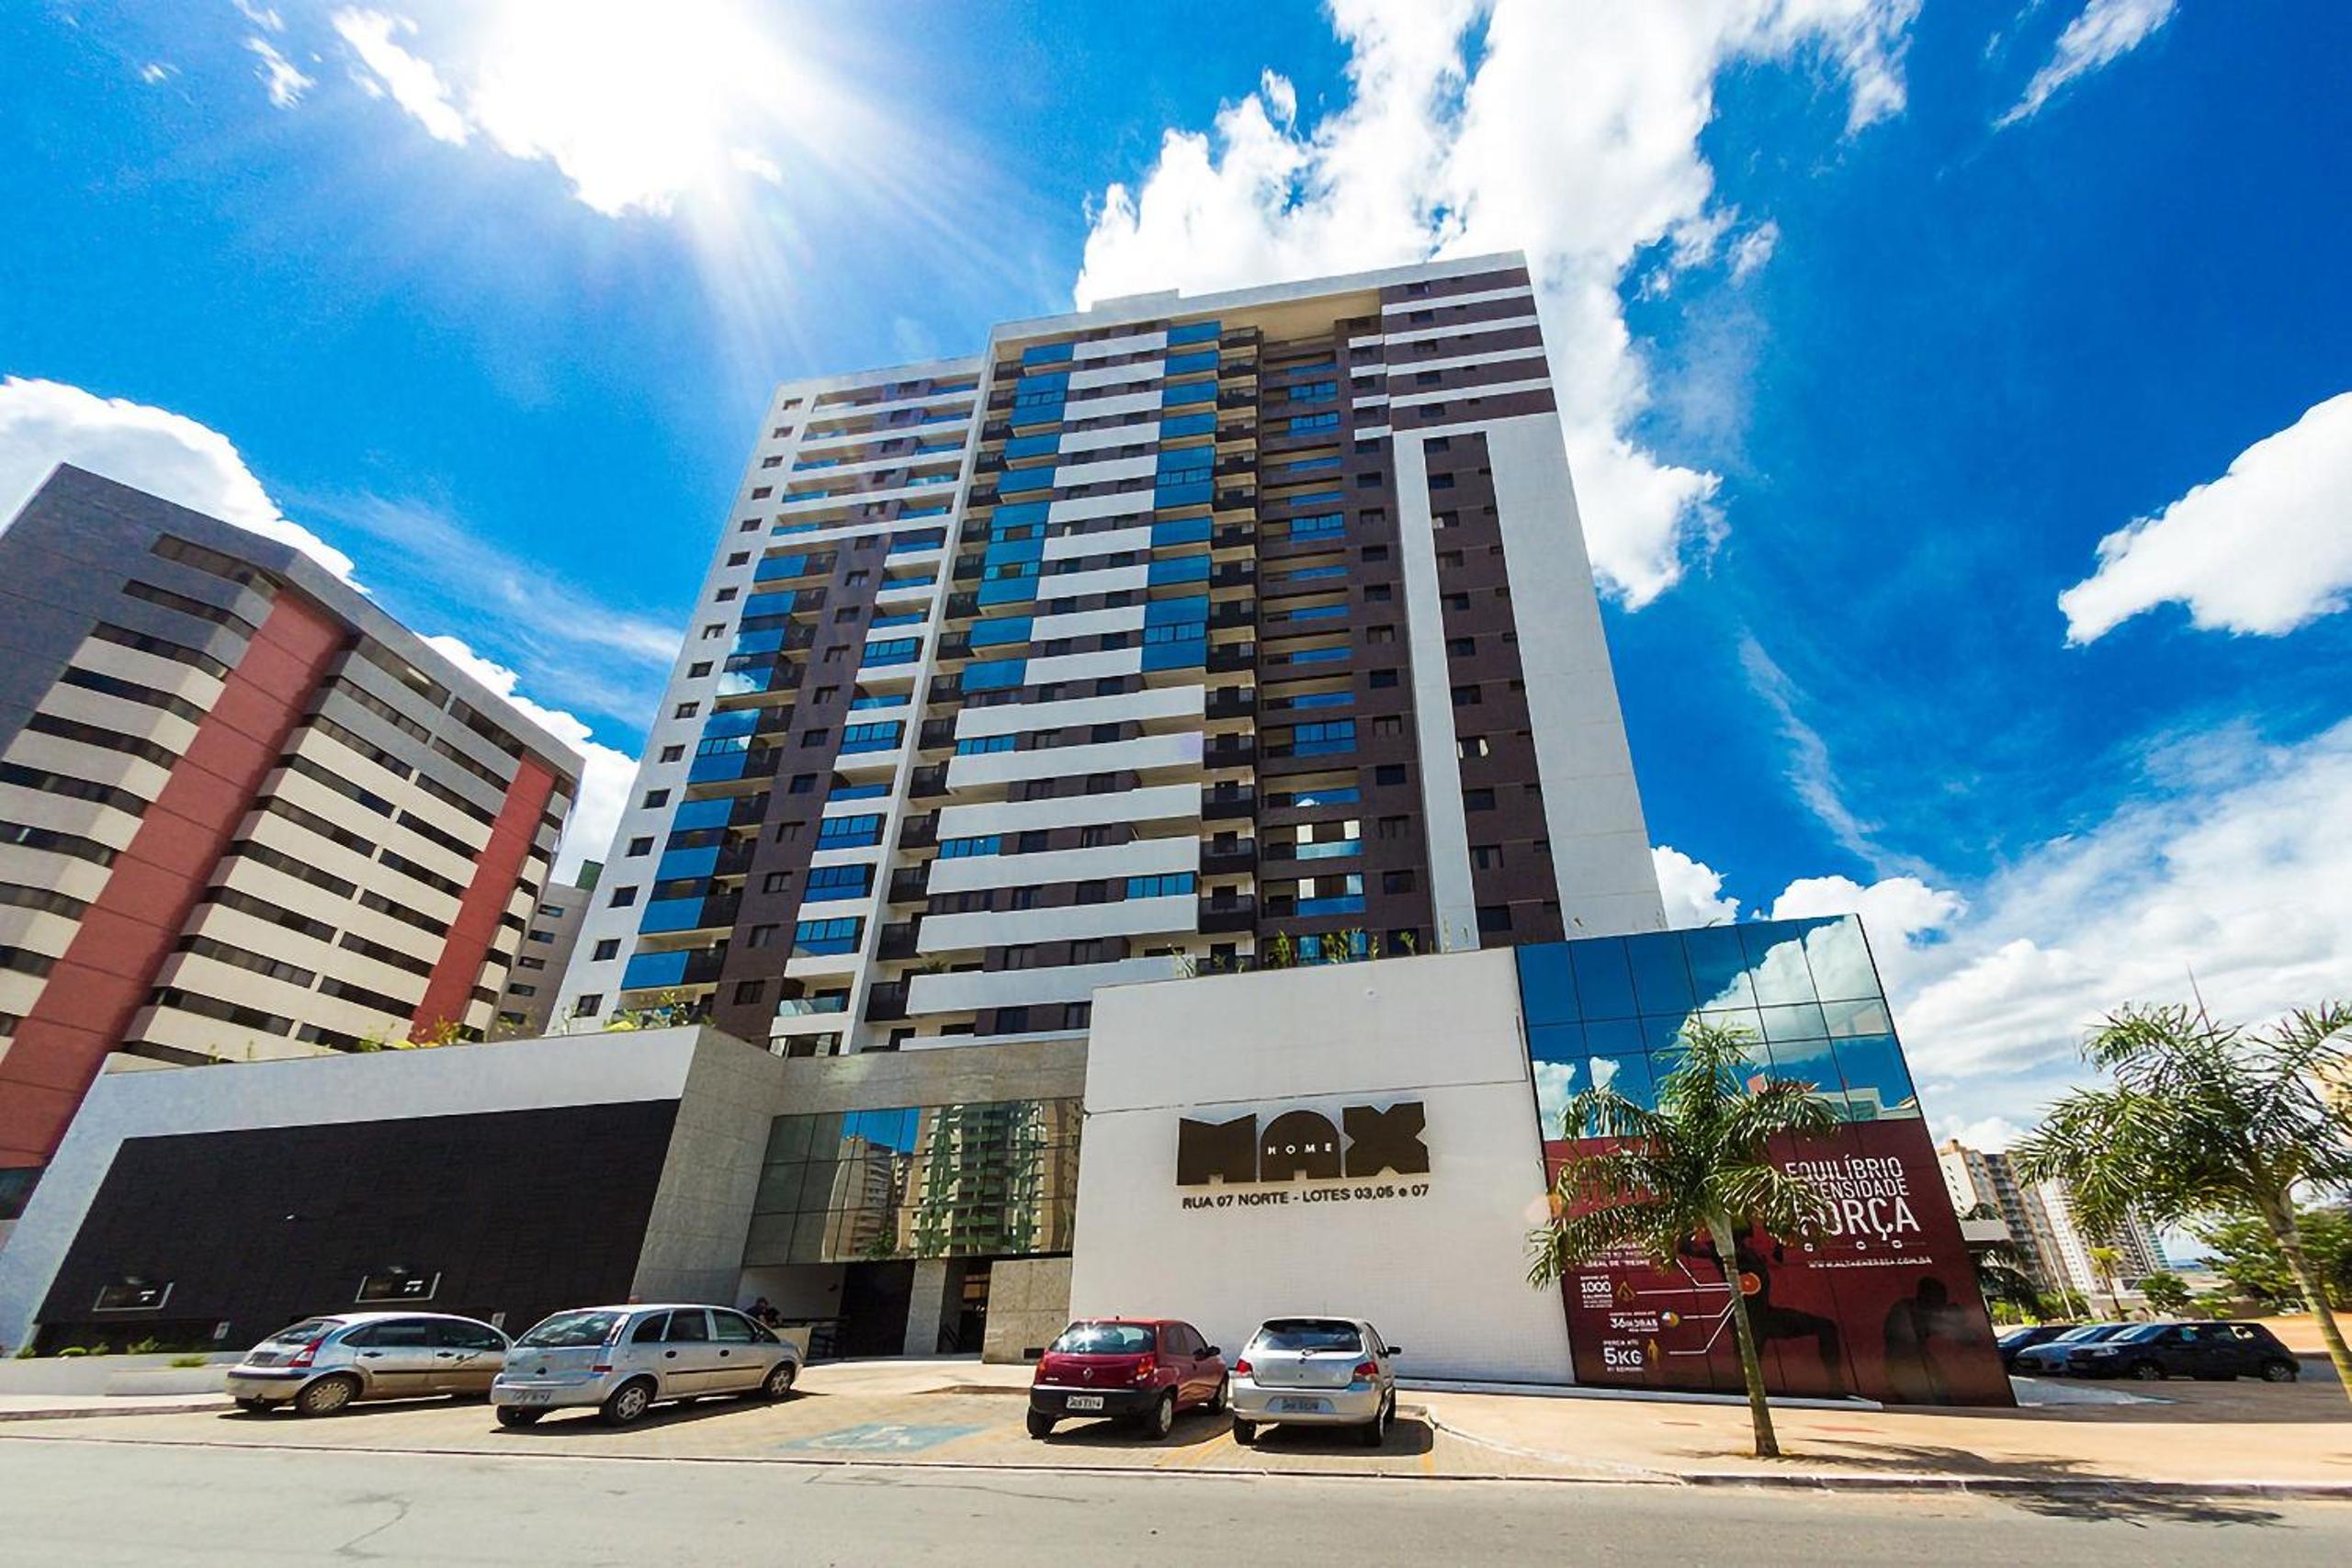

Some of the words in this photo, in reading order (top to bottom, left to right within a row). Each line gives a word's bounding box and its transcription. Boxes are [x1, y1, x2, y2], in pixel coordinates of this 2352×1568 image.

[1177, 1102, 1430, 1185] MAX
[1268, 1143, 1332, 1155] HOME
[1785, 1154, 1904, 1182] EQUILÍBRIO
[1182, 1196, 1214, 1209] RUA
[1216, 1195, 1234, 1207] 07
[1238, 1191, 1289, 1205] NORTE
[1302, 1188, 1351, 1202] LOTES
[1397, 1188, 1408, 1197] e
[1411, 1184, 1430, 1196] 07
[1807, 1178, 1910, 1201] TENSIDADE
[1581, 1280, 1611, 1293] 1000
[1604, 1347, 1642, 1365] 5KG
